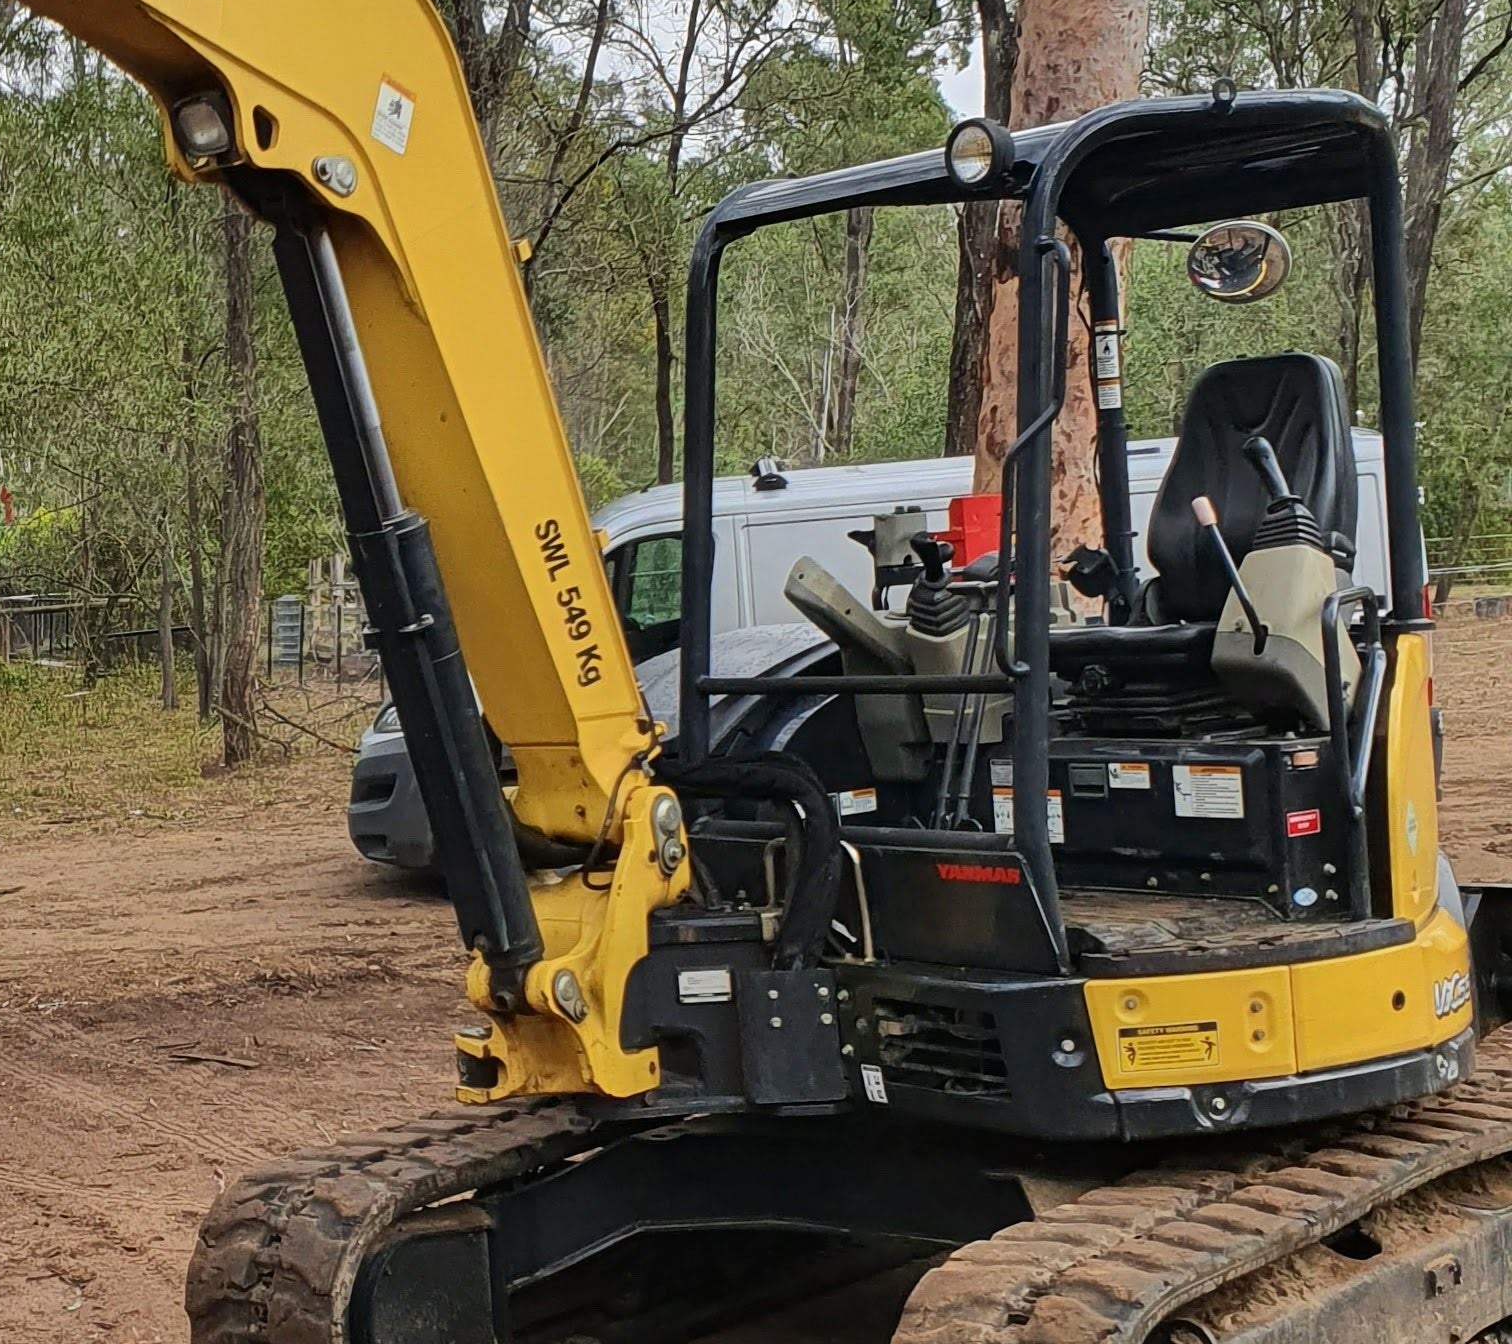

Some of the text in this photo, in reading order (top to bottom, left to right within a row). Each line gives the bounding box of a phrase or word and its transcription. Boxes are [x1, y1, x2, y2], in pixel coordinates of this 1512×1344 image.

[535, 519, 603, 687] SWL 549 Kg
[935, 863, 1021, 885] YANMAR
[1136, 1027, 1164, 1036] SAFETY
